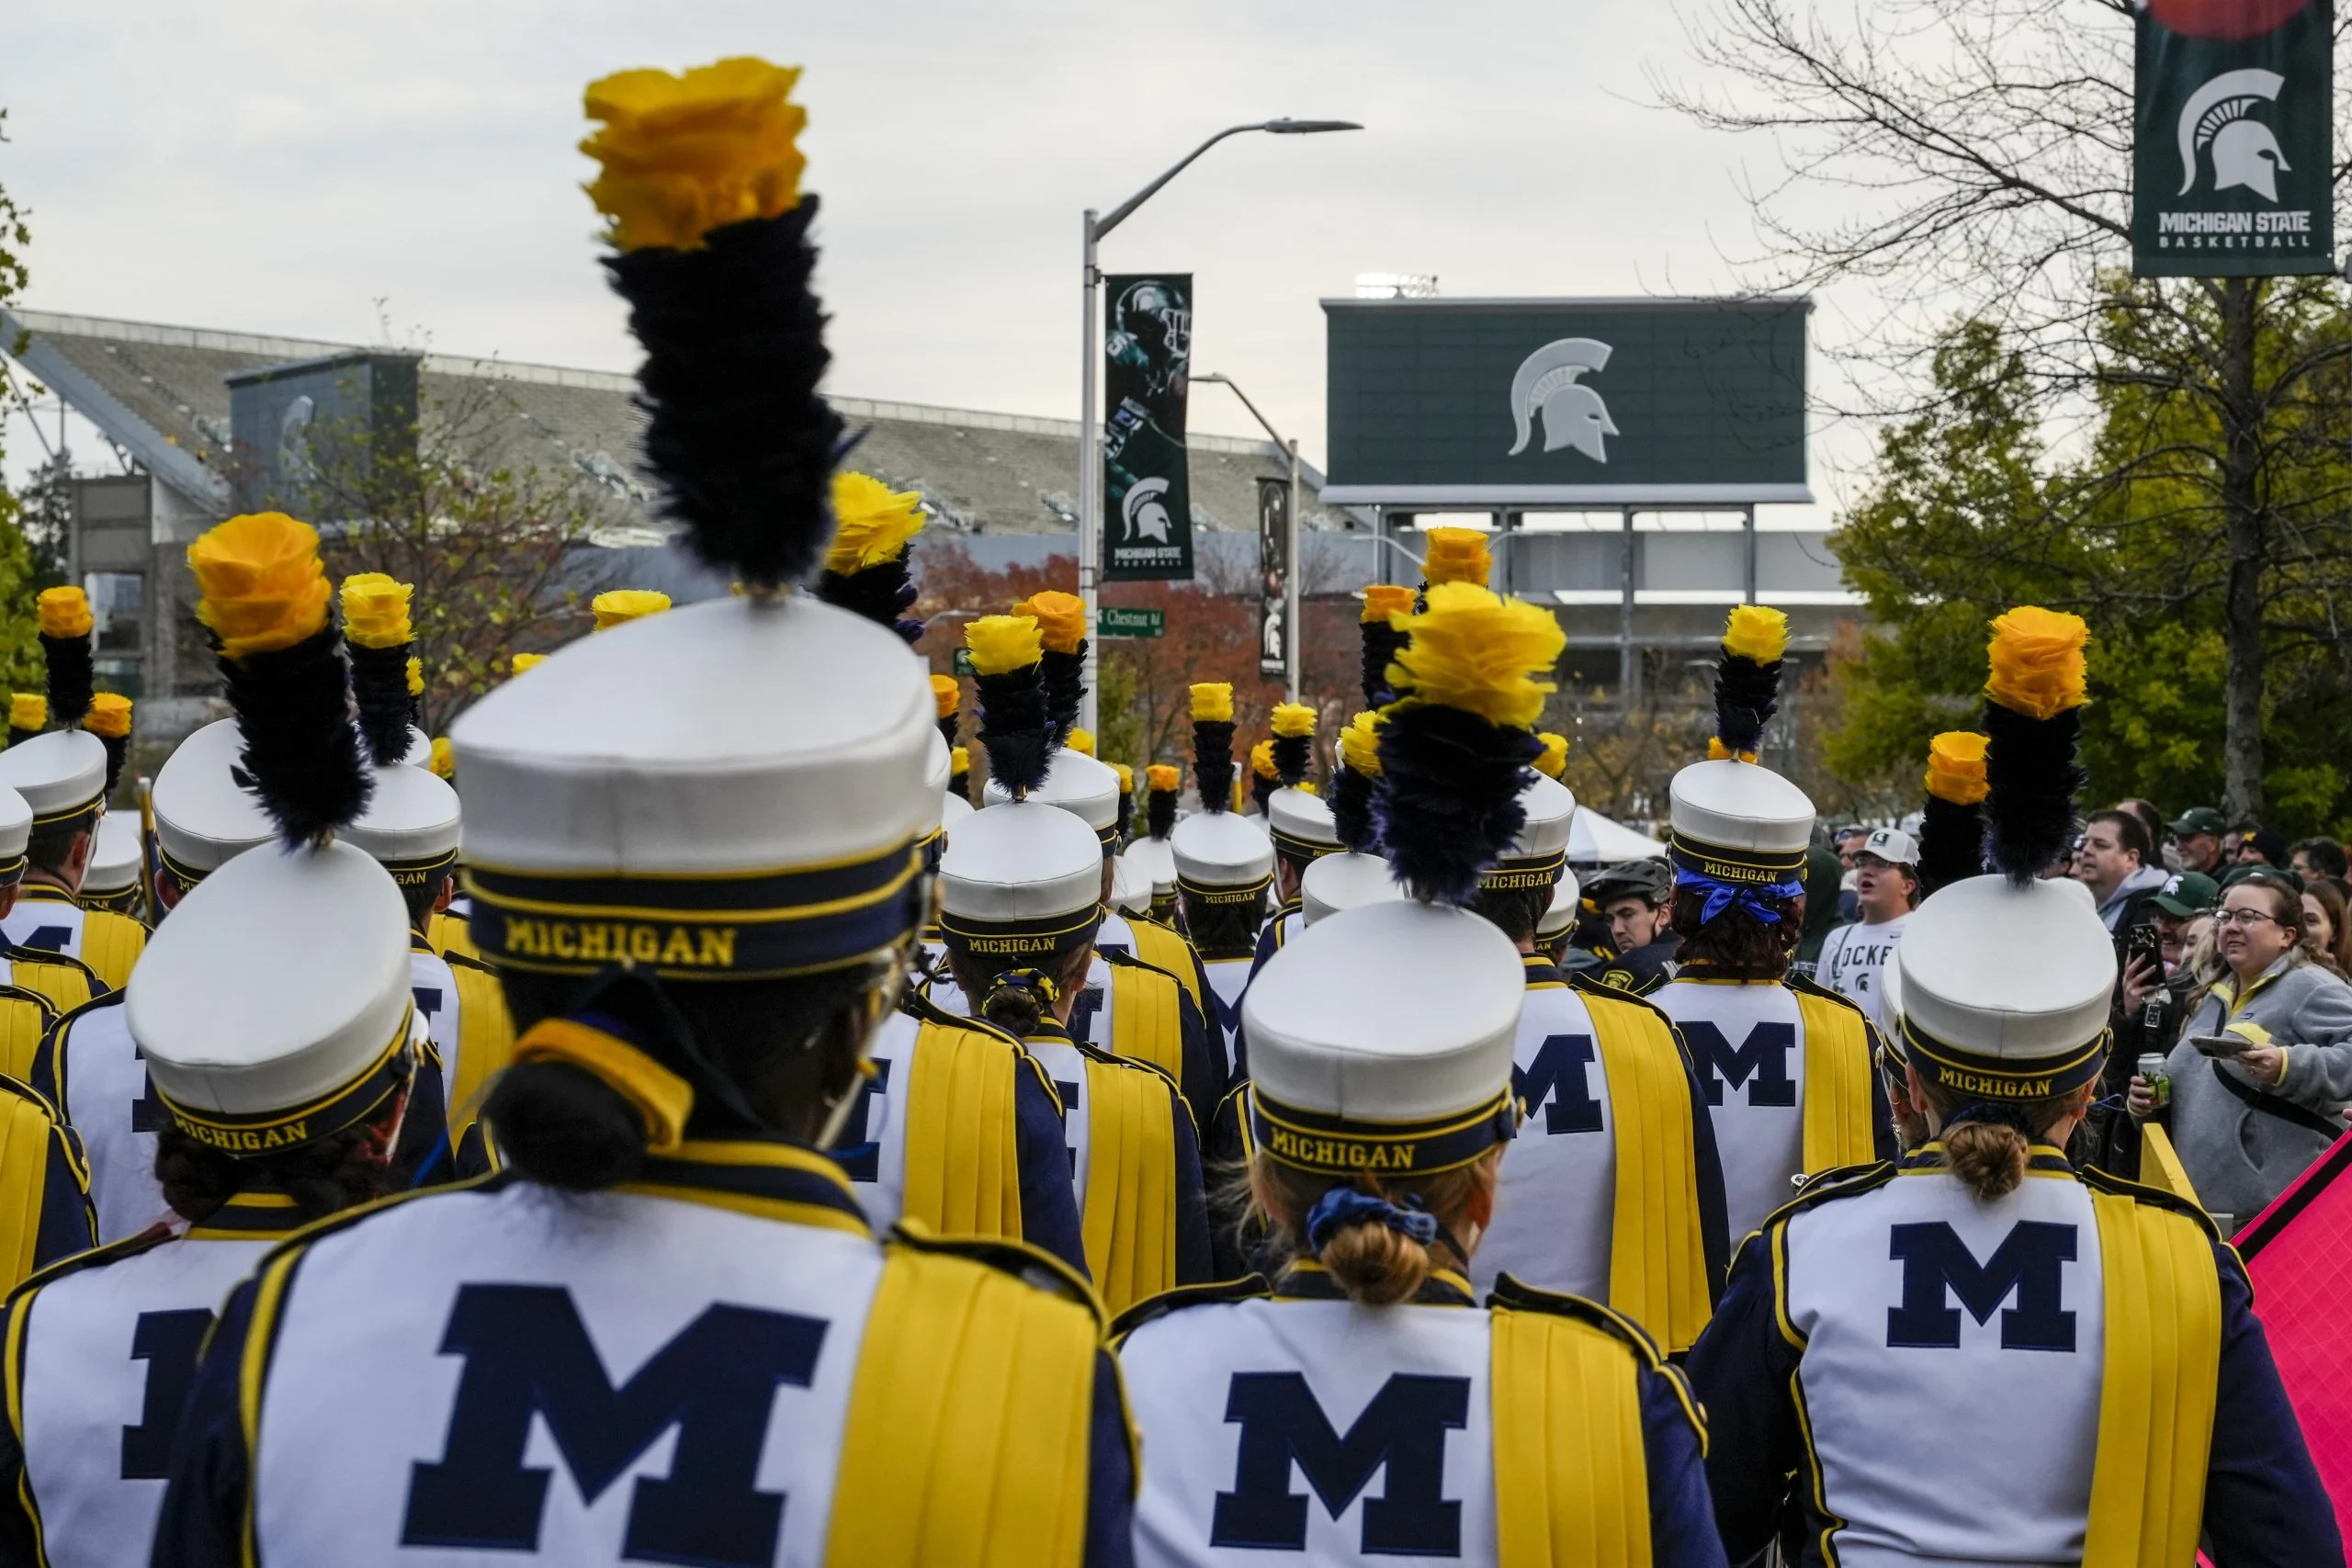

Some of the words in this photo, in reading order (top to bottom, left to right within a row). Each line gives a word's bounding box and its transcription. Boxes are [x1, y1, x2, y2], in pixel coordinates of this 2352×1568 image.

[2159, 212, 2252, 232] MICHIGAN
[2256, 211, 2312, 232] STATE
[2159, 235, 2311, 248] BASKETBALL
[1107, 609, 1148, 626] Chestnut
[1476, 871, 1555, 889] MICHIGAN
[1704, 862, 1778, 883] MICHIGAN
[1204, 892, 1256, 904] MICHIGAN
[504, 918, 737, 966] MICHIGAN
[968, 937, 1056, 953] MICHIGAN
[1675, 1021, 1796, 1107] M
[1939, 1066, 2052, 1096] MICHIGAN
[173, 1112, 307, 1150] MICHIGAN
[1271, 1126, 1415, 1168] MICHIGAN
[1886, 1220, 2077, 1353] M
[398, 1282, 831, 1568] M
[1210, 1371, 1471, 1558] M
